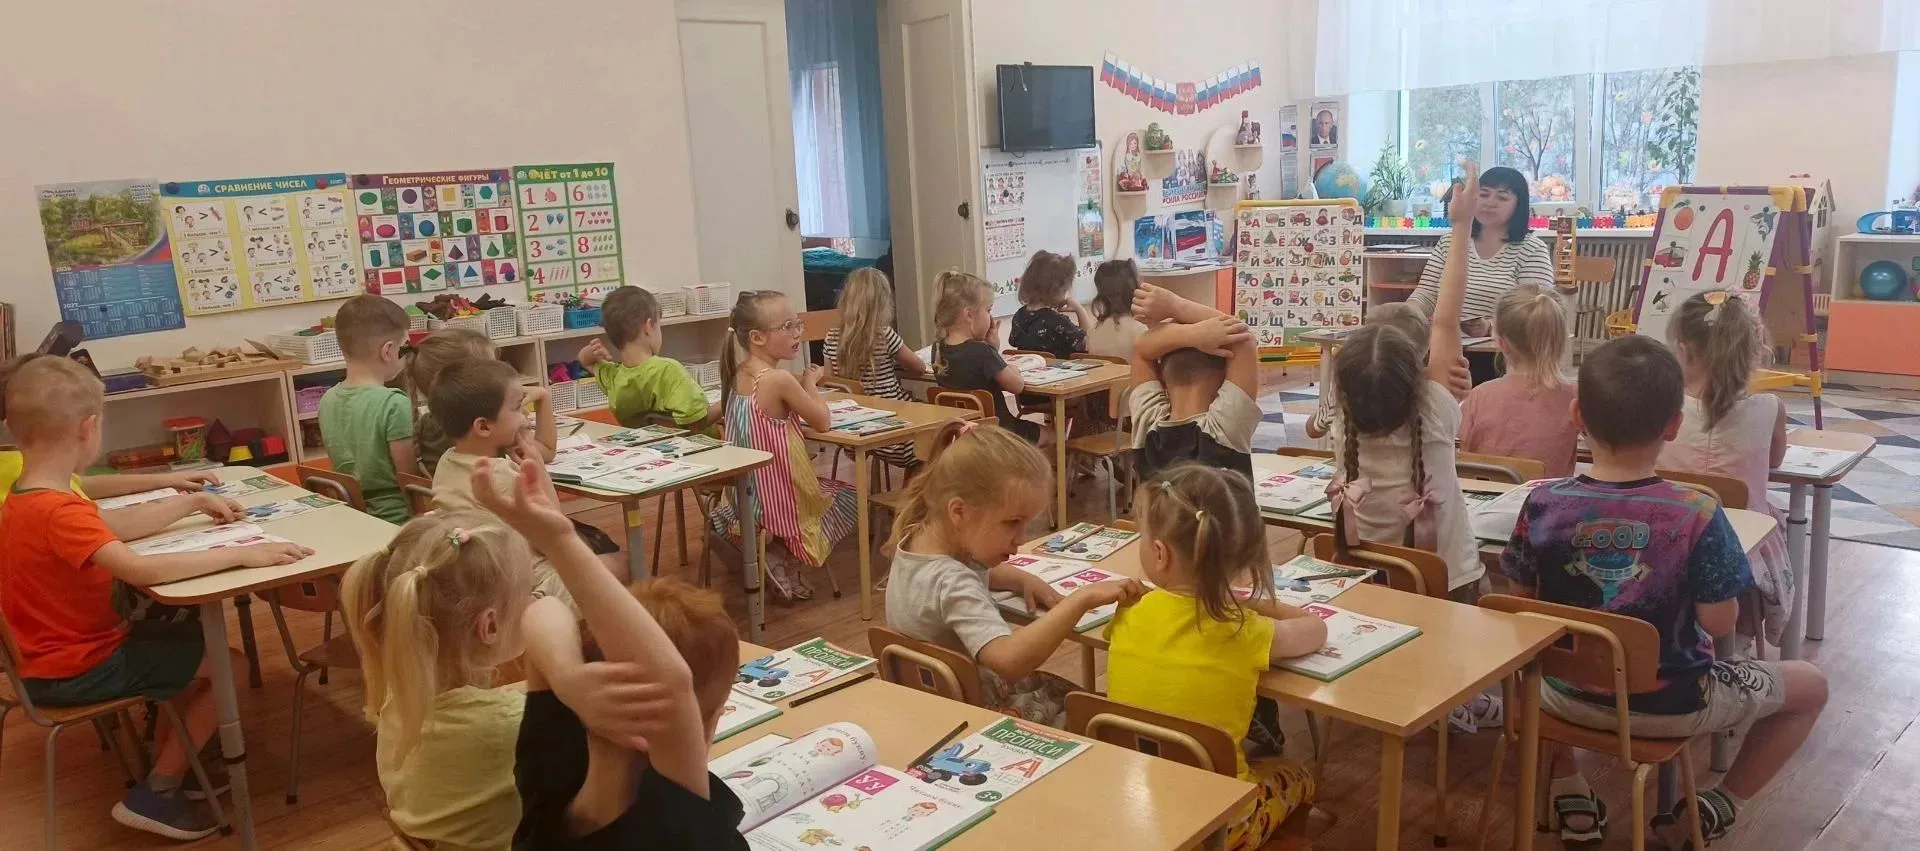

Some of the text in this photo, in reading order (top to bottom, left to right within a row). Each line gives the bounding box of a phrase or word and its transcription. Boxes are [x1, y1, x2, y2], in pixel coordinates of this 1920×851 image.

[572, 168, 579, 178] 1
[581, 170, 593, 179] до
[594, 166, 609, 177] 10
[214, 178, 308, 194] СРАВНЕНИЕ ЧИСЕЛ
[572, 184, 584, 202] 6
[524, 187, 536, 205] 1
[526, 214, 540, 232] 2
[575, 211, 586, 228] 7
[1251, 215, 1363, 228] А Б В Г Д
[529, 240, 542, 259] 3
[577, 236, 590, 254] 8
[1253, 235, 1362, 247] Е Ё Ж З И
[1692, 208, 1734, 283] А
[1250, 256, 1260, 267] Й
[1276, 257, 1284, 266] К
[1325, 256, 1336, 266] М
[1352, 255, 1362, 265] Н
[532, 266, 545, 285] 4
[580, 262, 592, 279] 9
[1249, 275, 1362, 287] О П Р С Т
[1249, 296, 1361, 307] У Ф Х Ц Ч
[1246, 317, 1258, 326] Ш
[1270, 317, 1284, 327] Щ
[1322, 317, 1334, 326] Ы
[1352, 316, 1360, 325] Э
[1273, 336, 1282, 346] Я
[991, 728, 1063, 756] ПРОПИСИ
[1000, 757, 1043, 778] А
